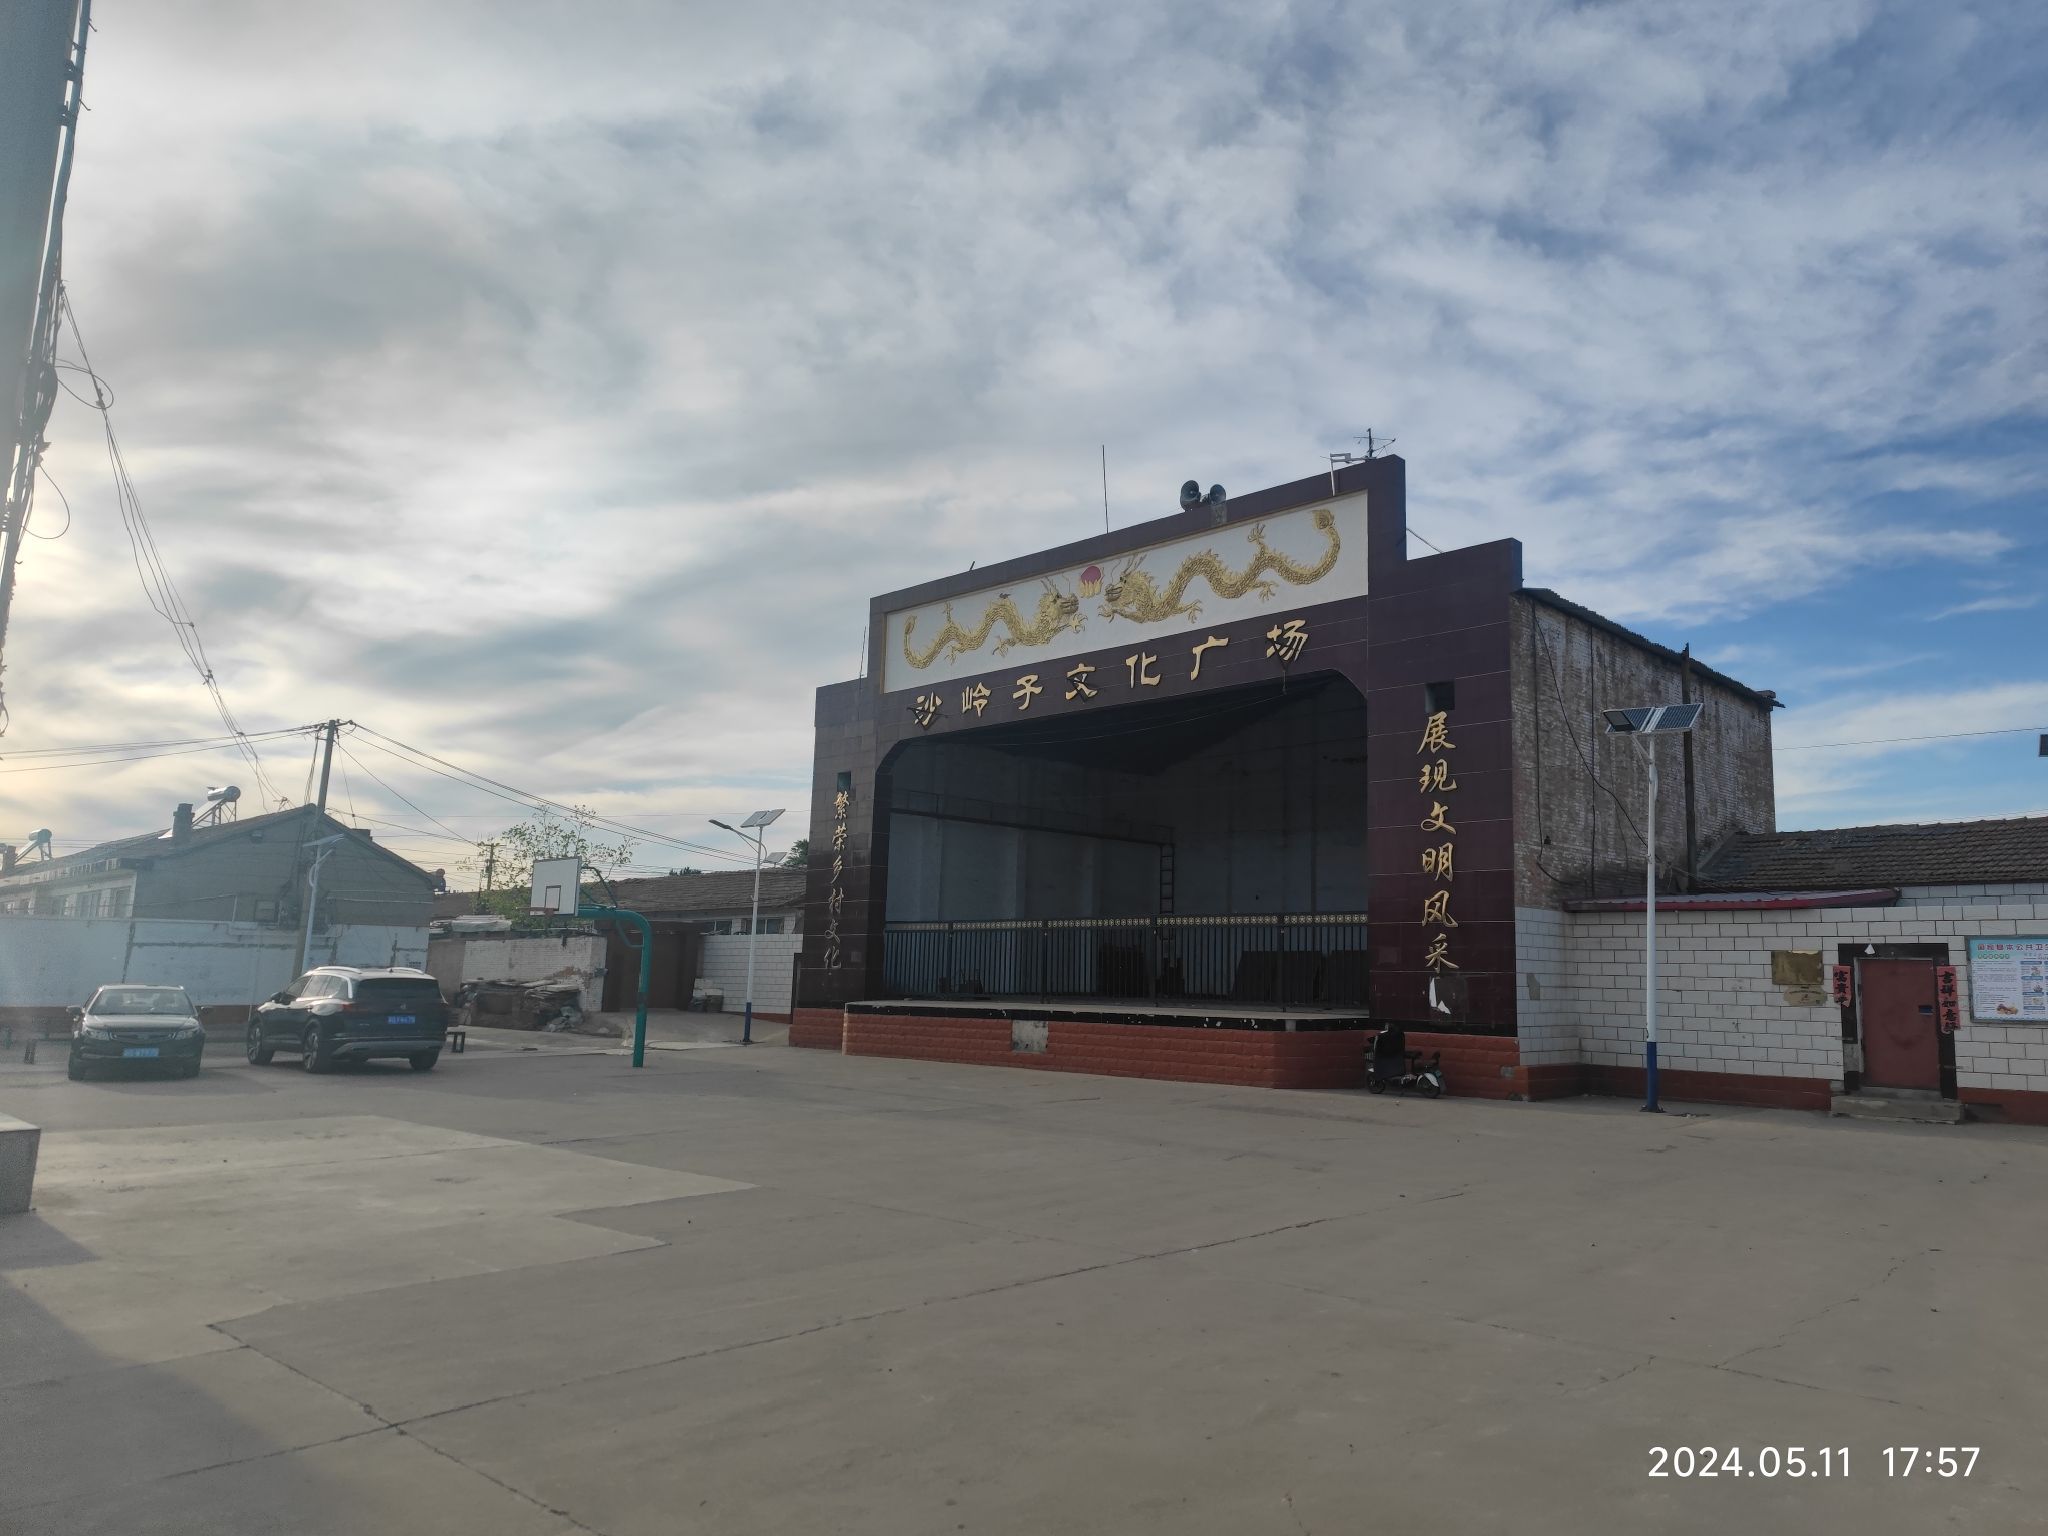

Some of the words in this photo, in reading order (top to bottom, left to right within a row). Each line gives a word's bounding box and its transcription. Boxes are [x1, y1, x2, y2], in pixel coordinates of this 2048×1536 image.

[913, 619, 1309, 726] 沙岭子文化广场
[823, 790, 850, 970] 繁荣乡村文化
[1416, 710, 1460, 974] 展现文明风采
